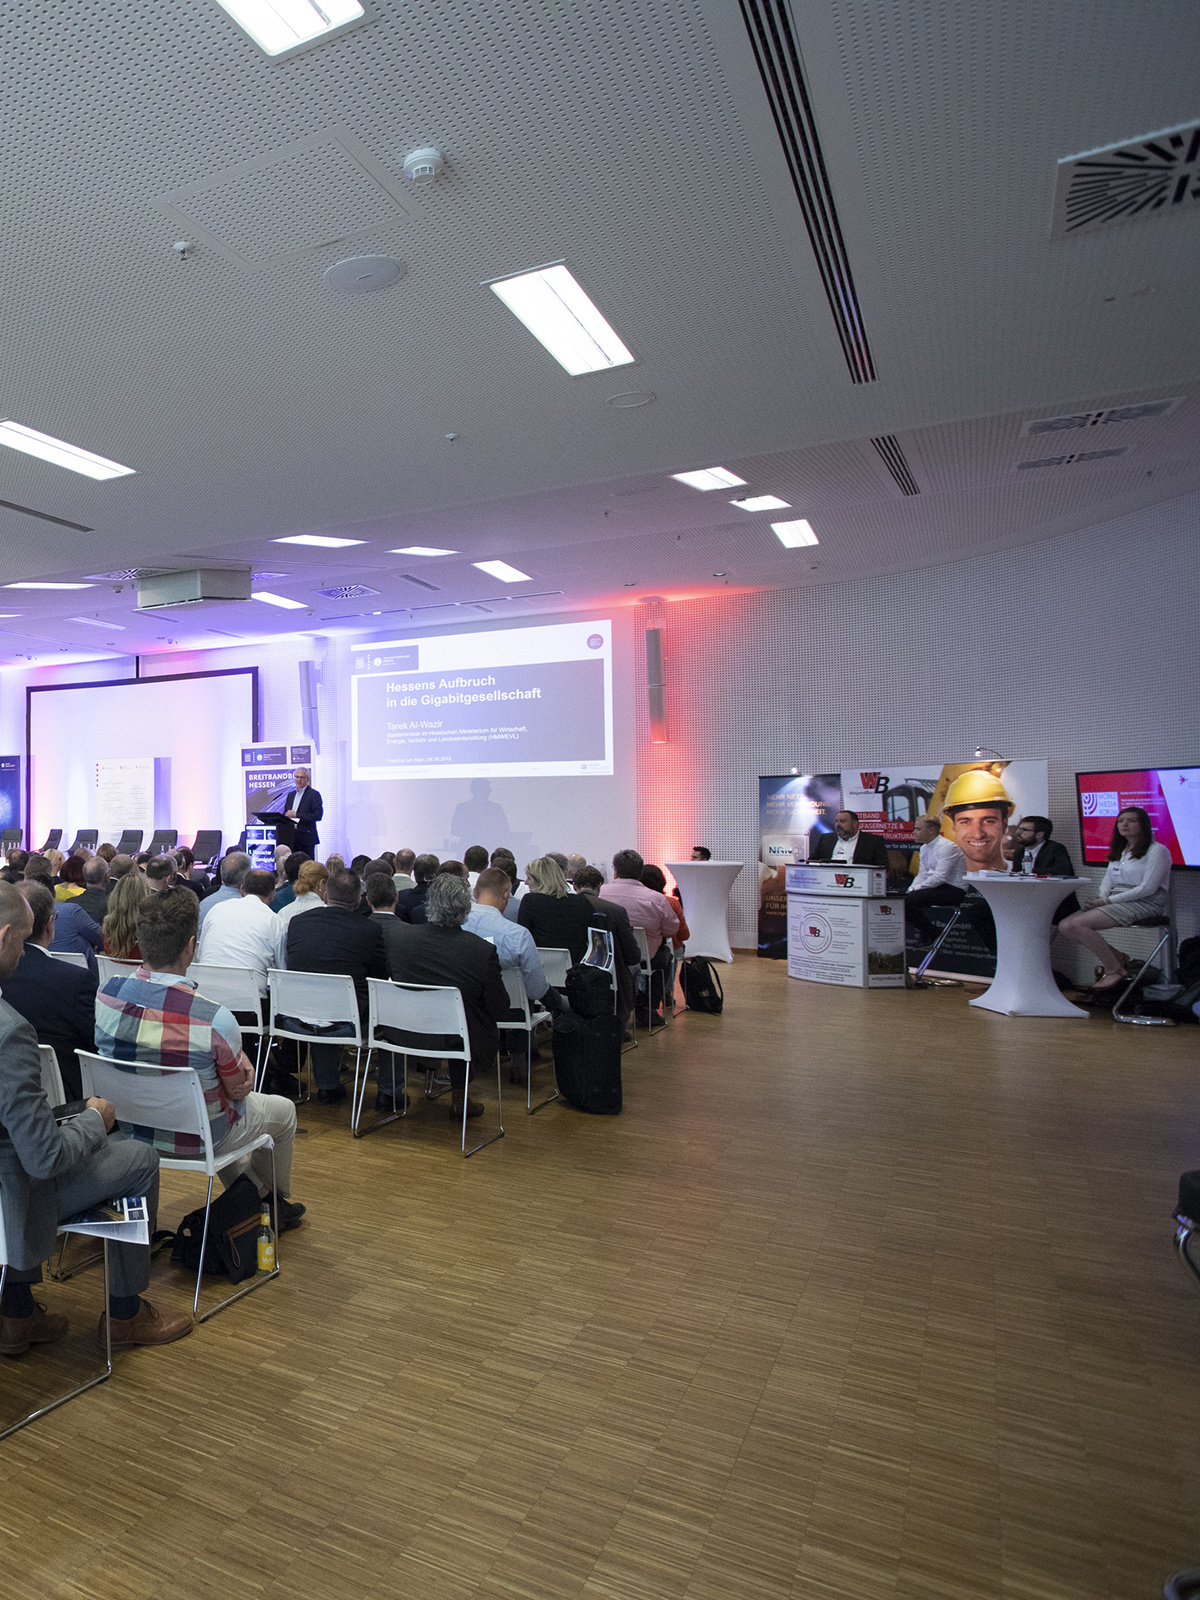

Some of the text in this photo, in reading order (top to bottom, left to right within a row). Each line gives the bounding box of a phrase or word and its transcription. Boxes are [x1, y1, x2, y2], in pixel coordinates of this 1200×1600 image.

[386, 675, 496, 692] Hessens Aufbruch
[386, 687, 541, 708] in die Gigabitgesellschaft
[386, 720, 443, 730] Tarek Al-Wazir
[249, 771, 296, 780] BREITBANDBÜ
